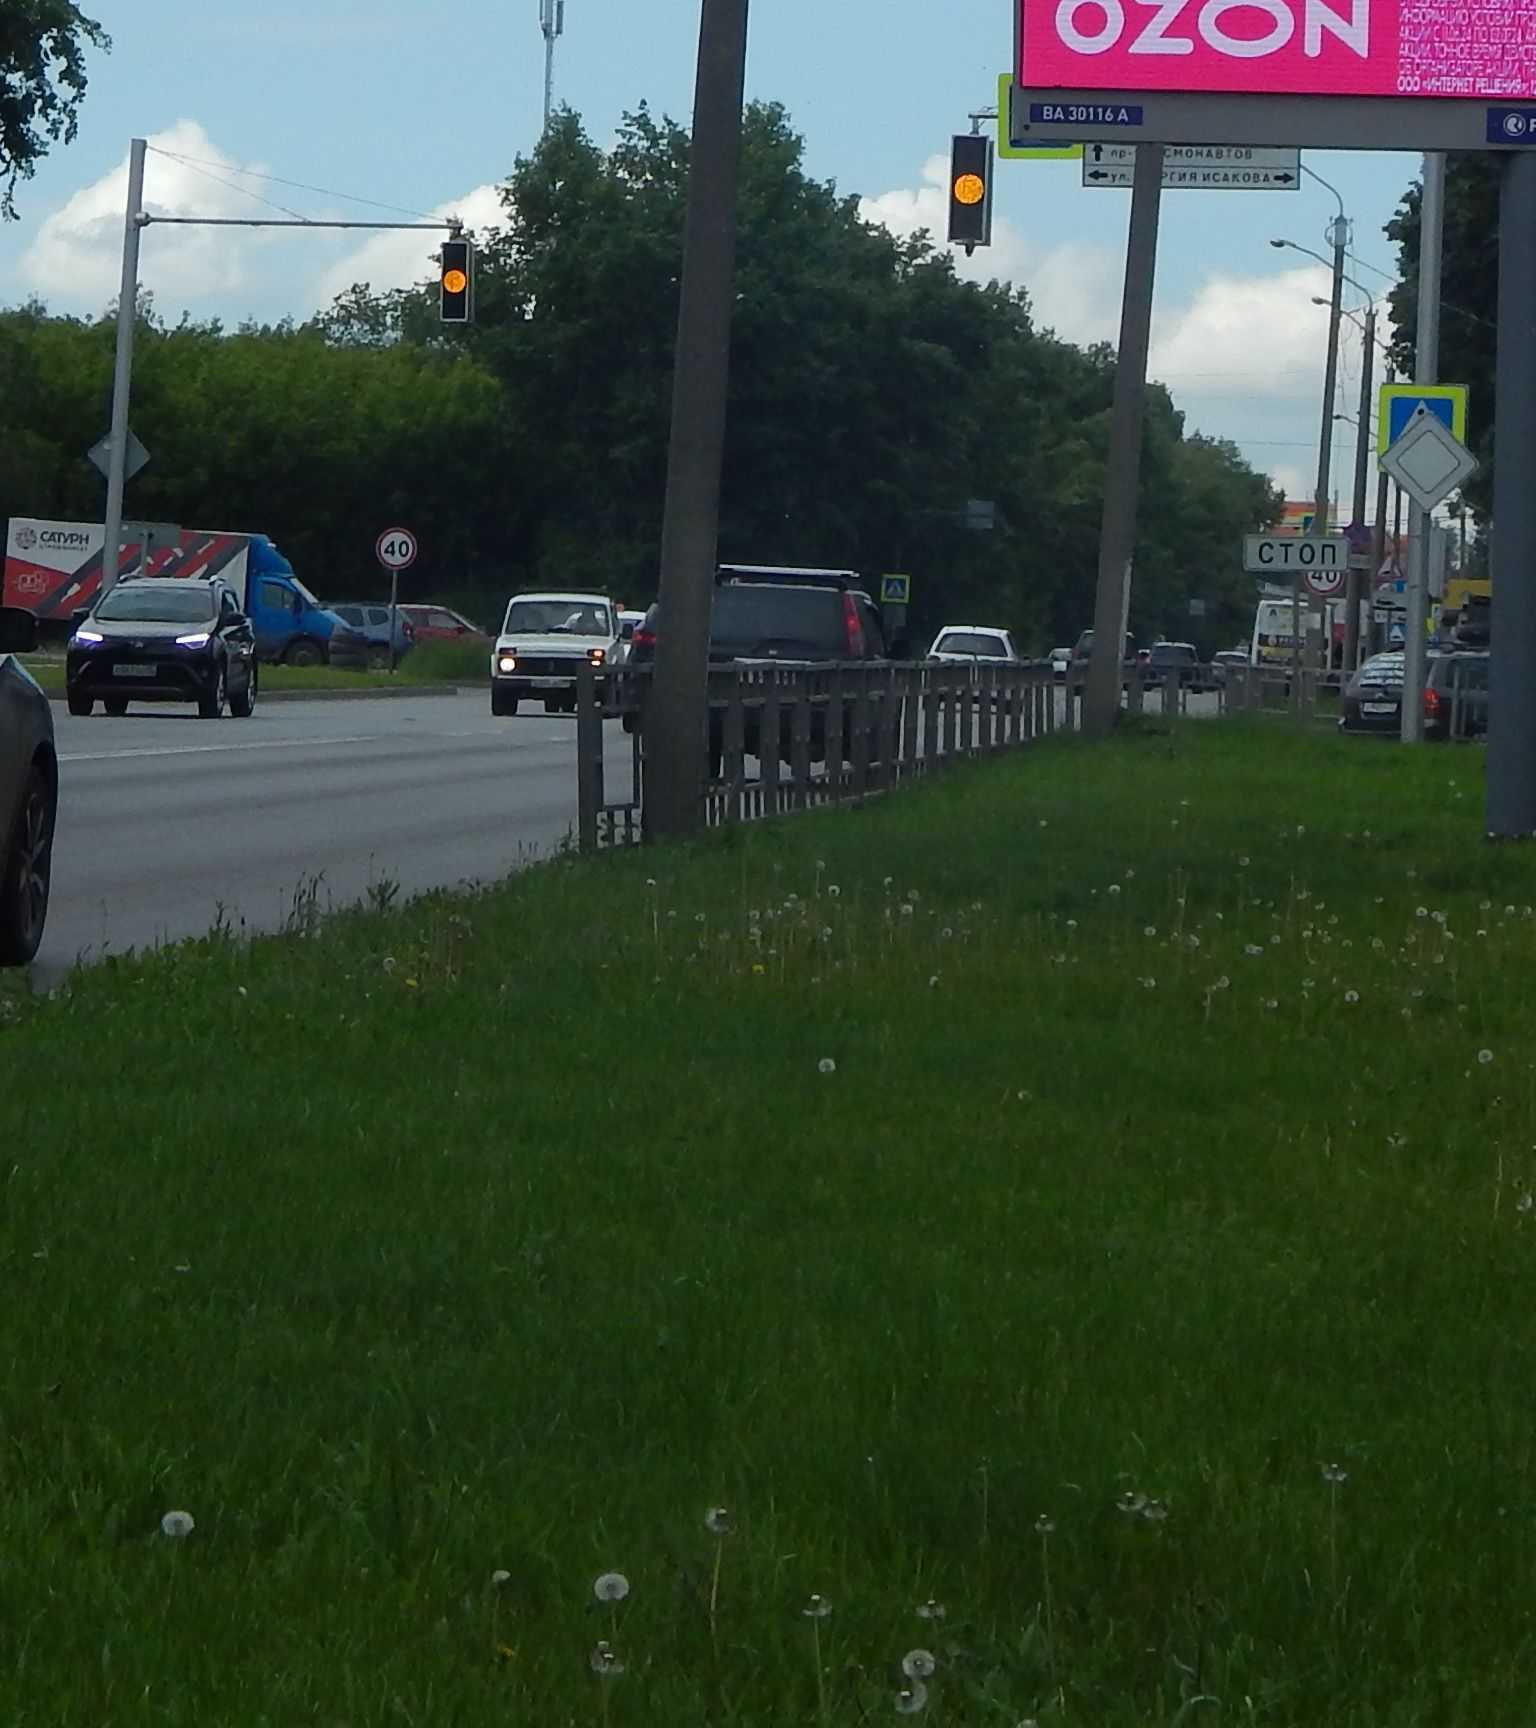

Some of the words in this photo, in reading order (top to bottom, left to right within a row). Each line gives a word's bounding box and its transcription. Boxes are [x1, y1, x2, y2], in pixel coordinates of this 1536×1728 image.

[1068, 107, 1114, 122] 30116
[1202, 172, 1271, 184] ИСАКОВА
[40, 531, 89, 545] САТУРН
[384, 540, 410, 558] 40
[1258, 542, 1337, 565] СТОП
[1311, 571, 1338, 584] 40
